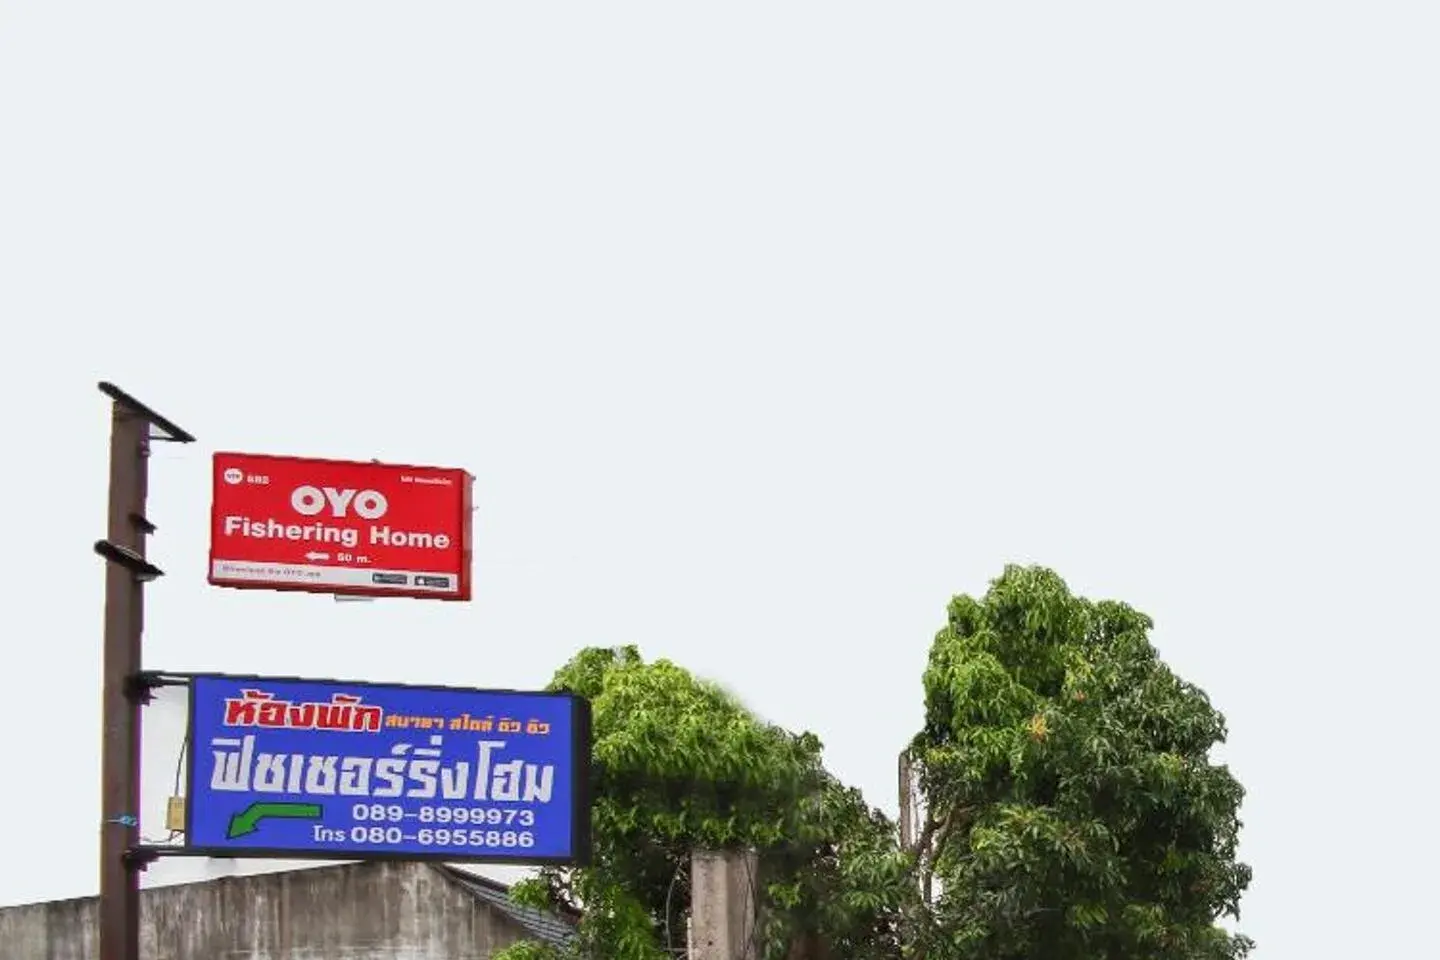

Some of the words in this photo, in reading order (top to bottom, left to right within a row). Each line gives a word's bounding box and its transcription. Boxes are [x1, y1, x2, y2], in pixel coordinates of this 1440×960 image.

[291, 485, 388, 519] OYO
[224, 516, 358, 547] Fishering
[370, 525, 450, 549] Home
[224, 688, 383, 732] ห้องพัก
[352, 803, 535, 827] 089-8999973
[351, 826, 534, 848] 080-6955886
